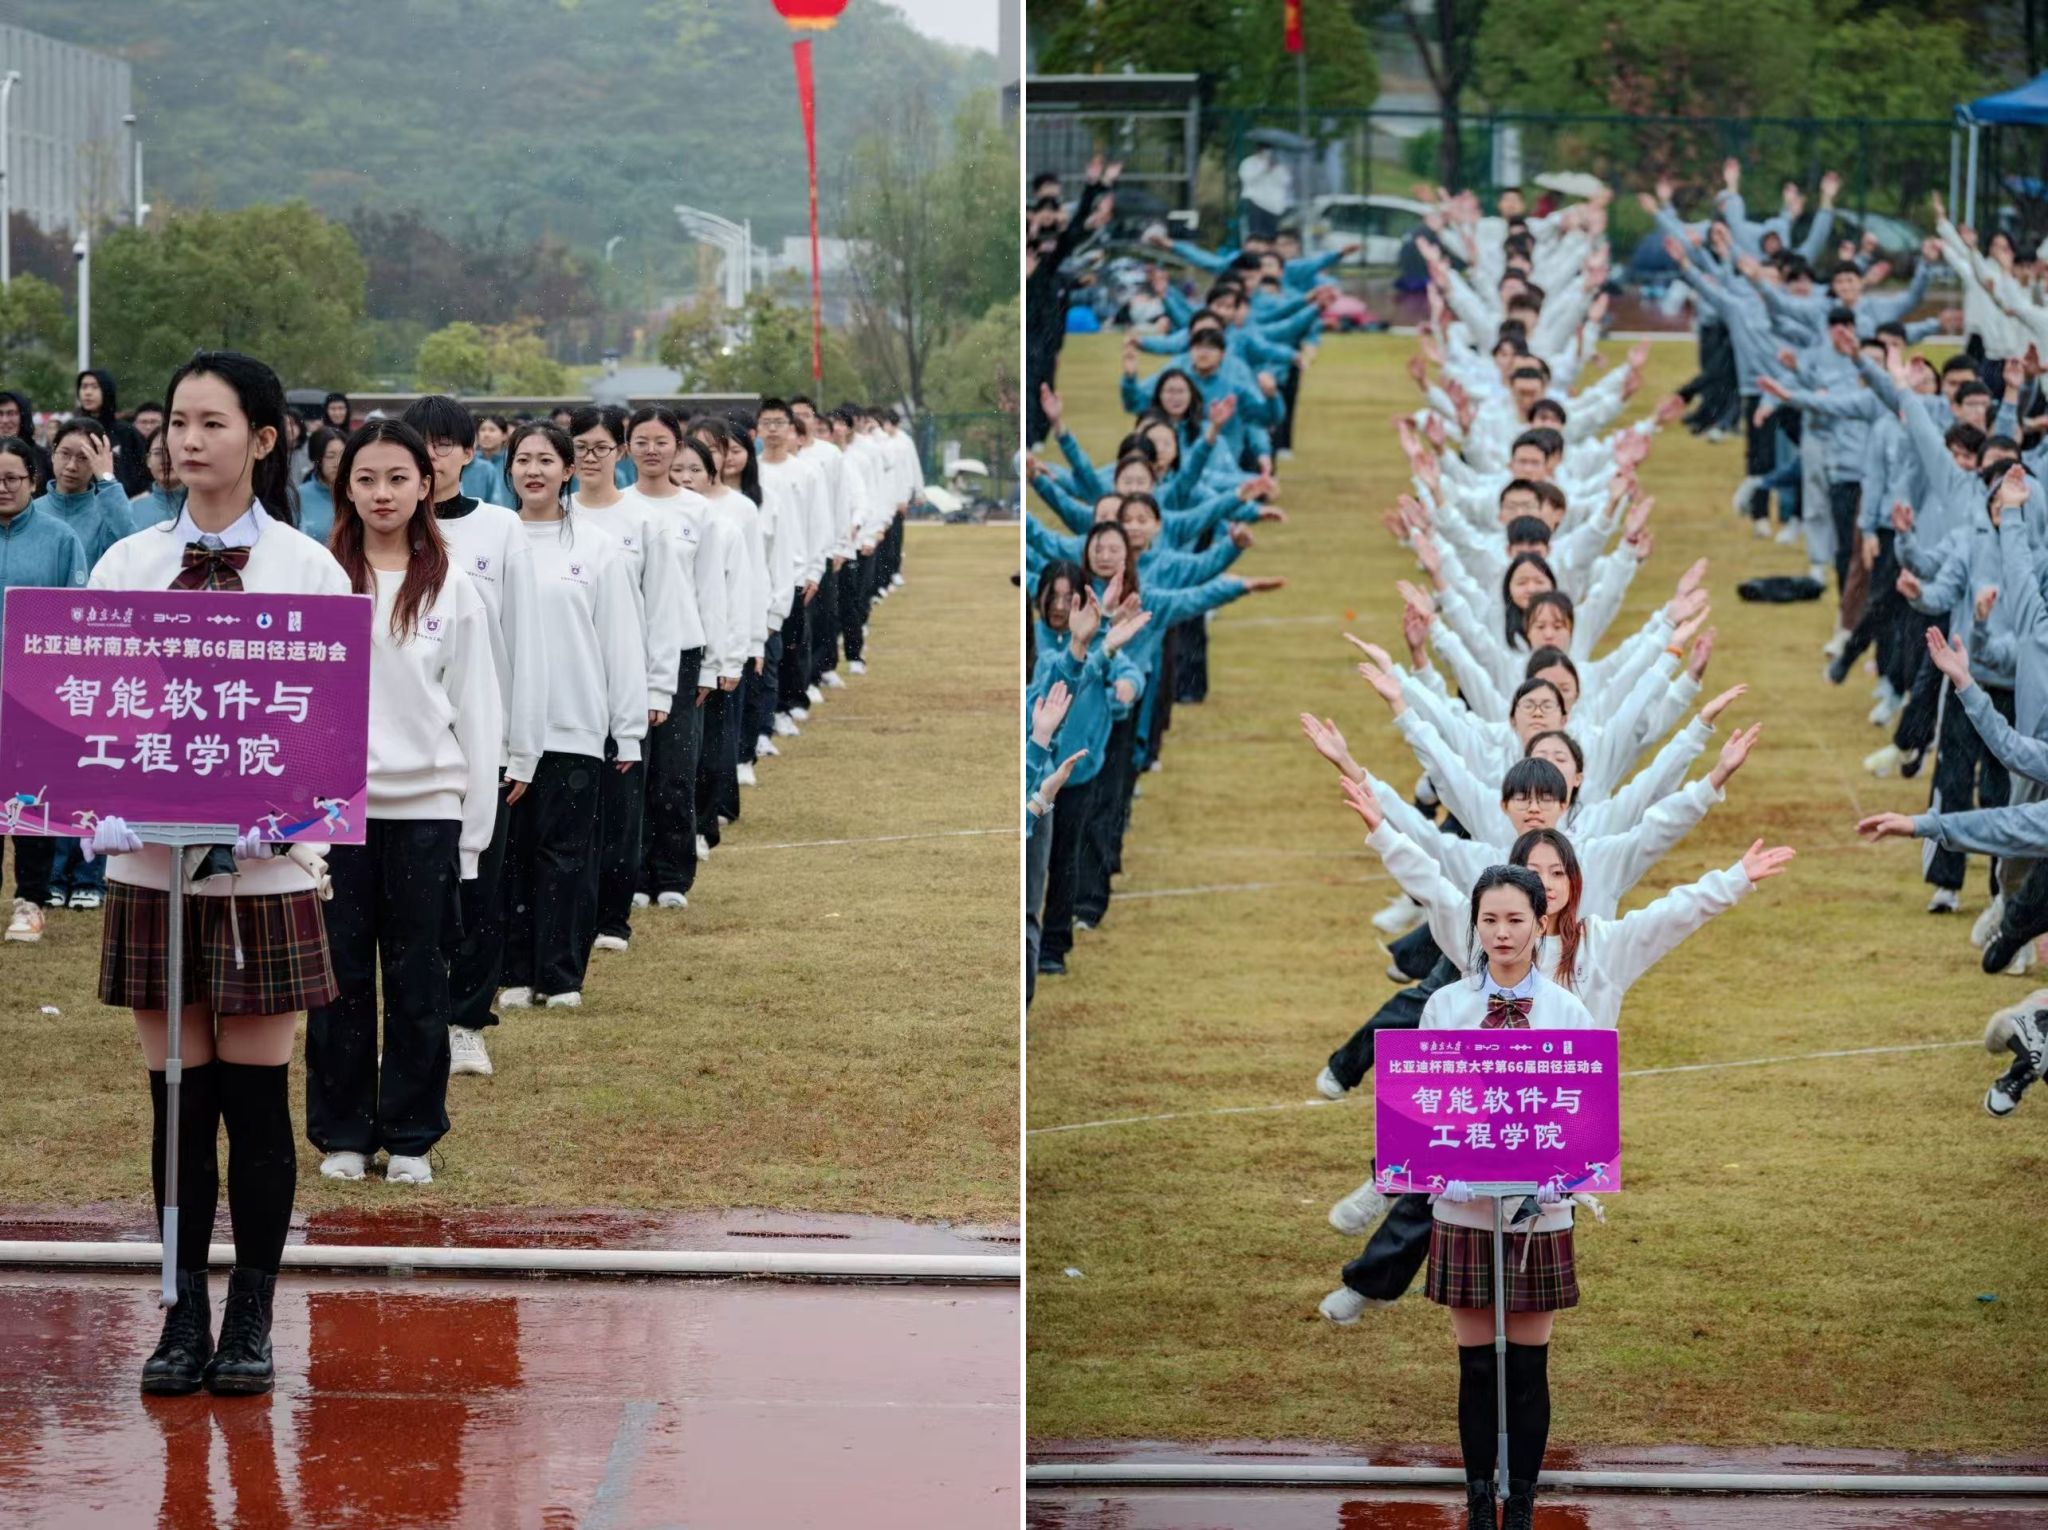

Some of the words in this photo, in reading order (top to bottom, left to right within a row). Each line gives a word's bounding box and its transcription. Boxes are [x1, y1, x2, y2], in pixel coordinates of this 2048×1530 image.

[153, 612, 191, 623] BYD
[24, 634, 347, 662] 比亚迪杯南京大学第66届田径运动会
[55, 675, 313, 723] 智能软件与
[77, 733, 285, 776] 工程学院
[1389, 1060, 1603, 1074] 比亚迪杯南京大学第66届田径运动会
[1411, 1086, 1582, 1114] 智能软件与
[1429, 1121, 1567, 1150] 工程学院
